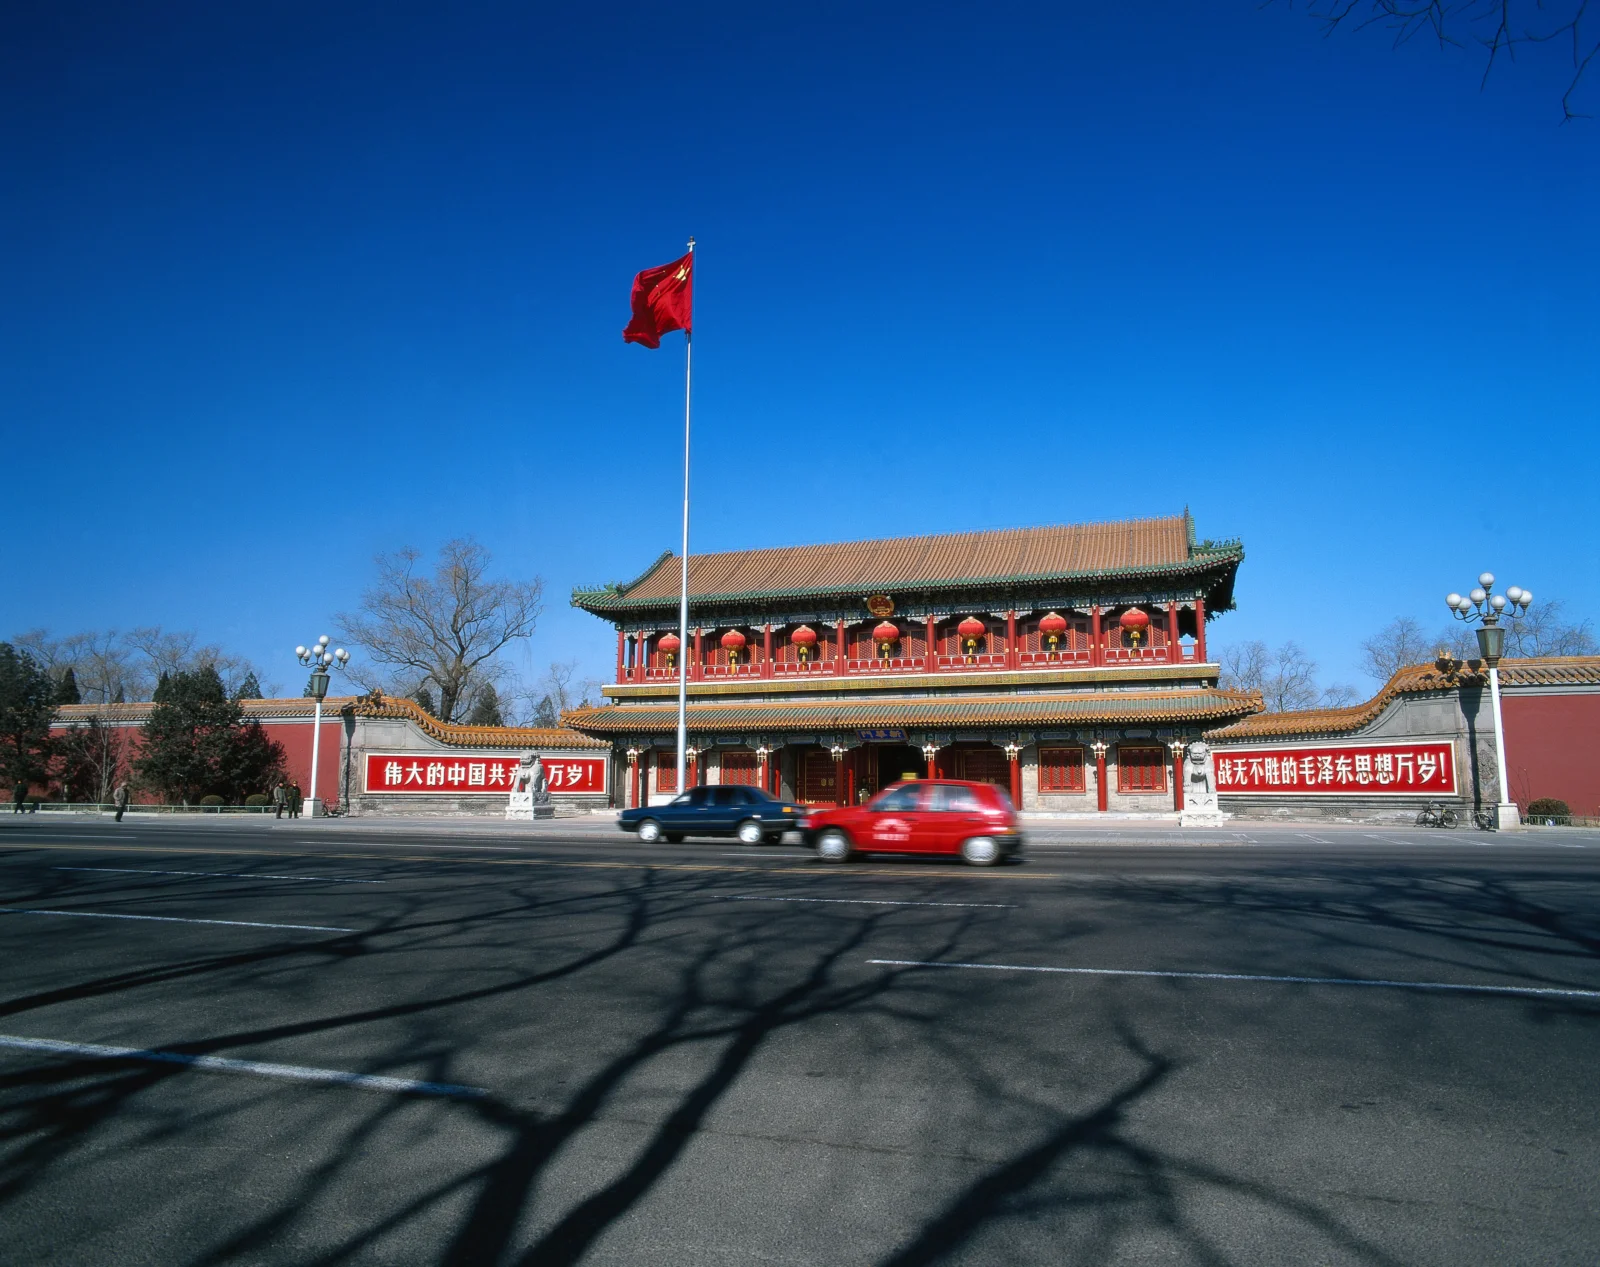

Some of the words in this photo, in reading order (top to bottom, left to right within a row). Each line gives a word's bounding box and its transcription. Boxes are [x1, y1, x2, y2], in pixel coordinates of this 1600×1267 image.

[383, 761, 593, 787] 伟大的中国共产万岁！
[1217, 752, 1447, 785] 战无不胜的毛泽东思想万岁！
